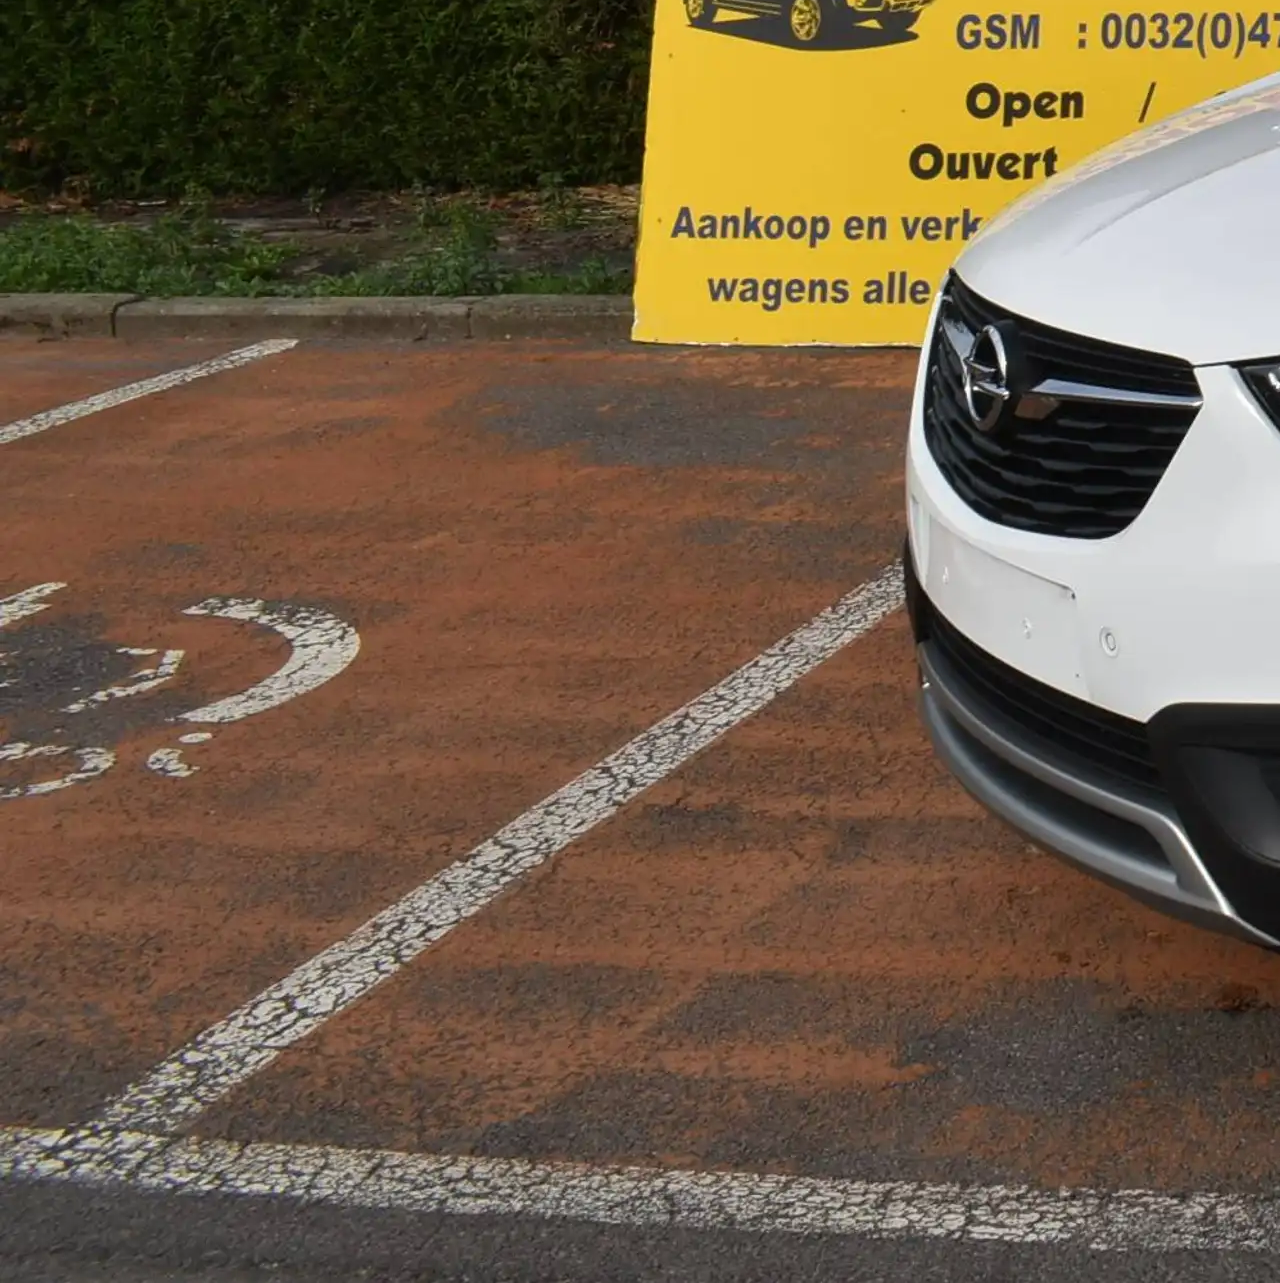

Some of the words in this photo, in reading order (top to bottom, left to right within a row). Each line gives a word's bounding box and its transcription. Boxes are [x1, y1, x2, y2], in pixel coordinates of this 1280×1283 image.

[956, 13, 1041, 50] GSM
[965, 82, 1084, 128] Open
[908, 142, 1058, 181] Ouvert
[670, 206, 831, 249] Aankoop
[843, 215, 887, 241] en
[707, 278, 850, 313] wagens
[862, 270, 931, 305] alle
